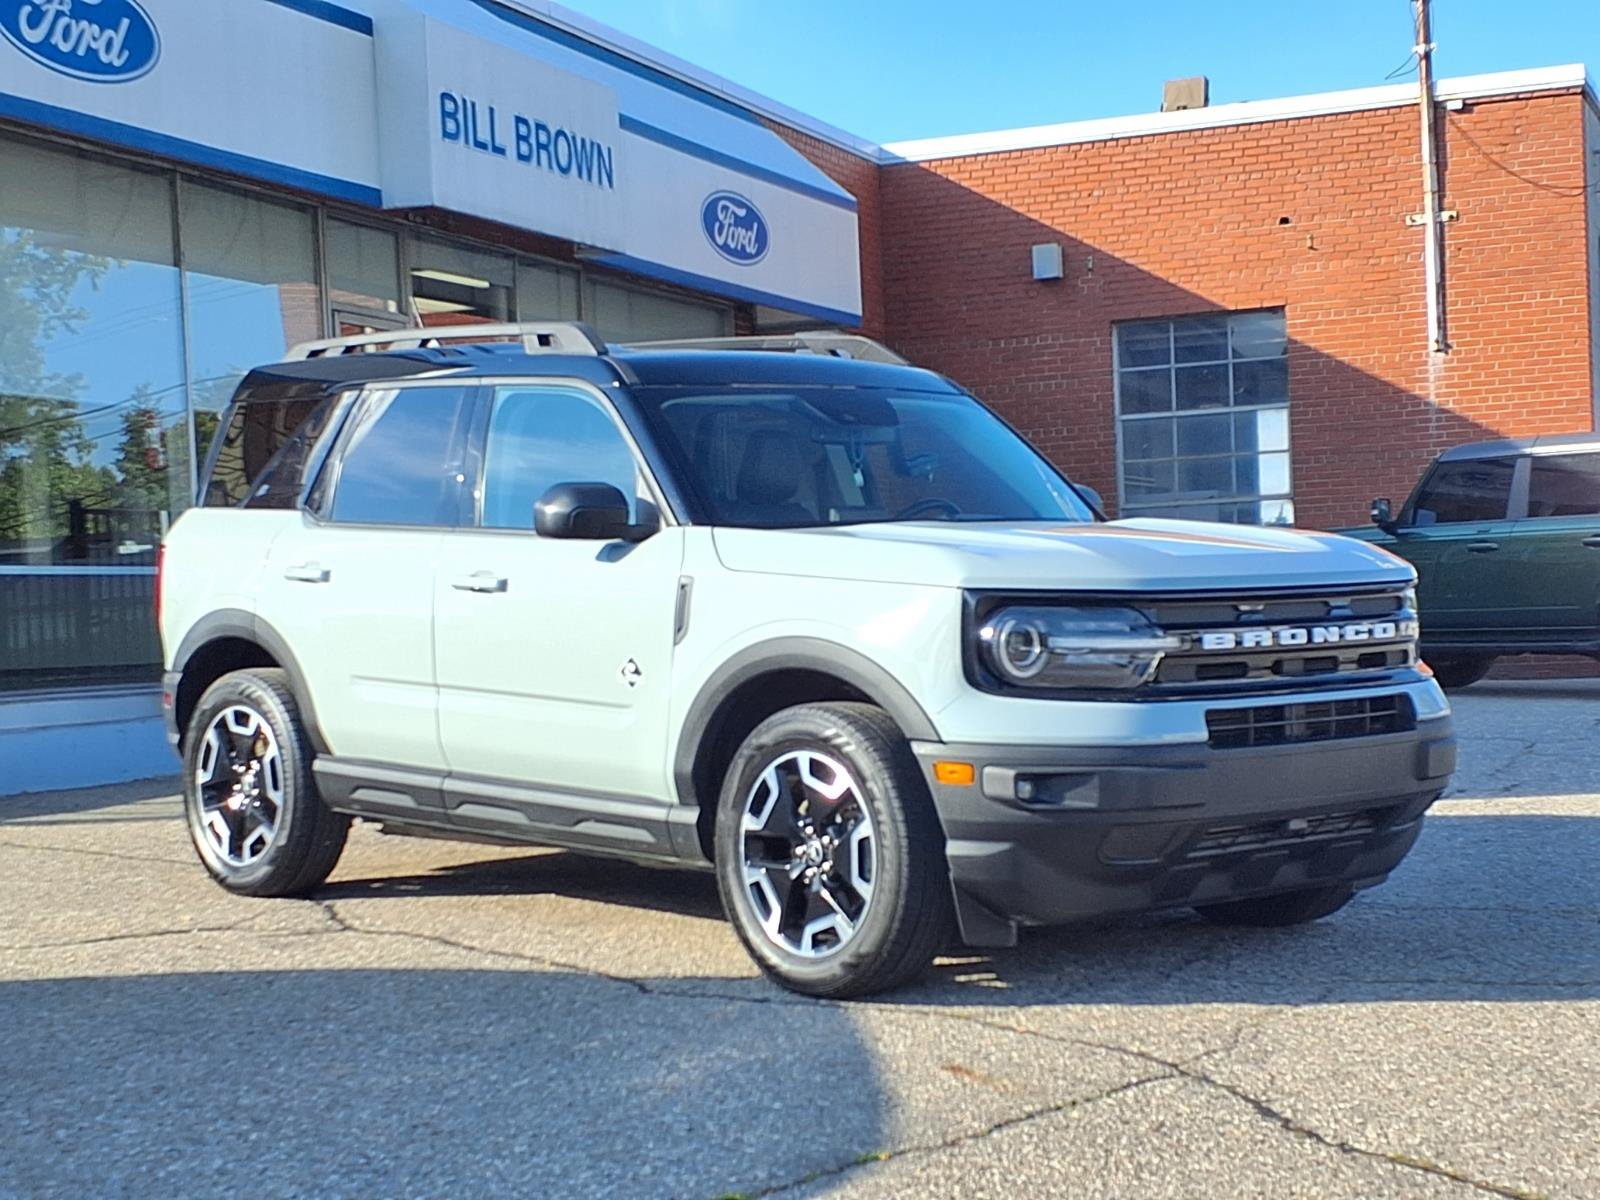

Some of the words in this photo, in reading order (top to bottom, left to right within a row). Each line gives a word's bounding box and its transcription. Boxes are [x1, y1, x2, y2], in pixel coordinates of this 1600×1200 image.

[18, 0, 131, 67] Ford
[440, 91, 506, 156] BILL
[514, 114, 614, 190] BROWN
[714, 200, 758, 255] Ford
[1202, 622, 1396, 650] BRONCO
